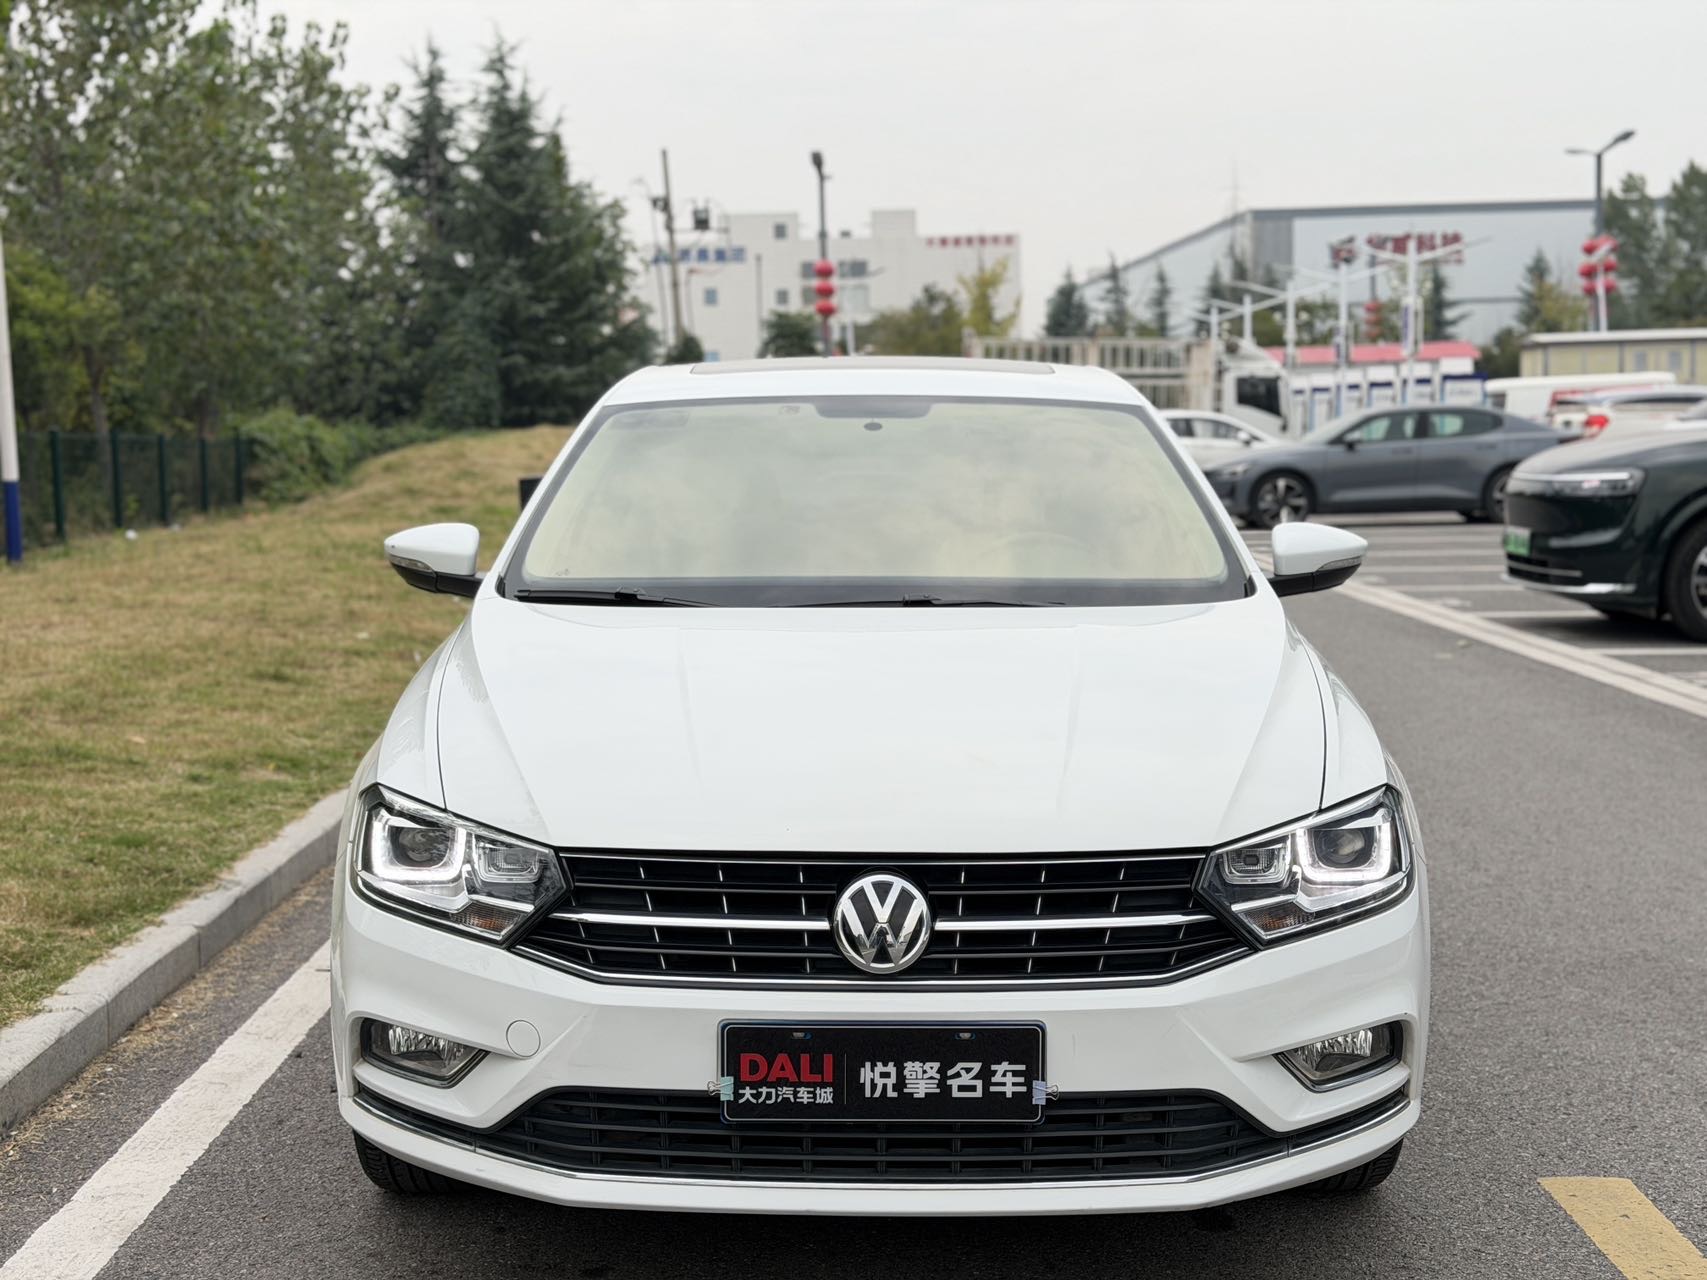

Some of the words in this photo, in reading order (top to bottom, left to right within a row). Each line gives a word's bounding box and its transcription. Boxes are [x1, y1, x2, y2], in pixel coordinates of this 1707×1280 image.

[739, 1053, 834, 1082] DALI
[860, 1061, 1027, 1099] 悦擎名车
[738, 1086, 834, 1105] 大力汽车城
